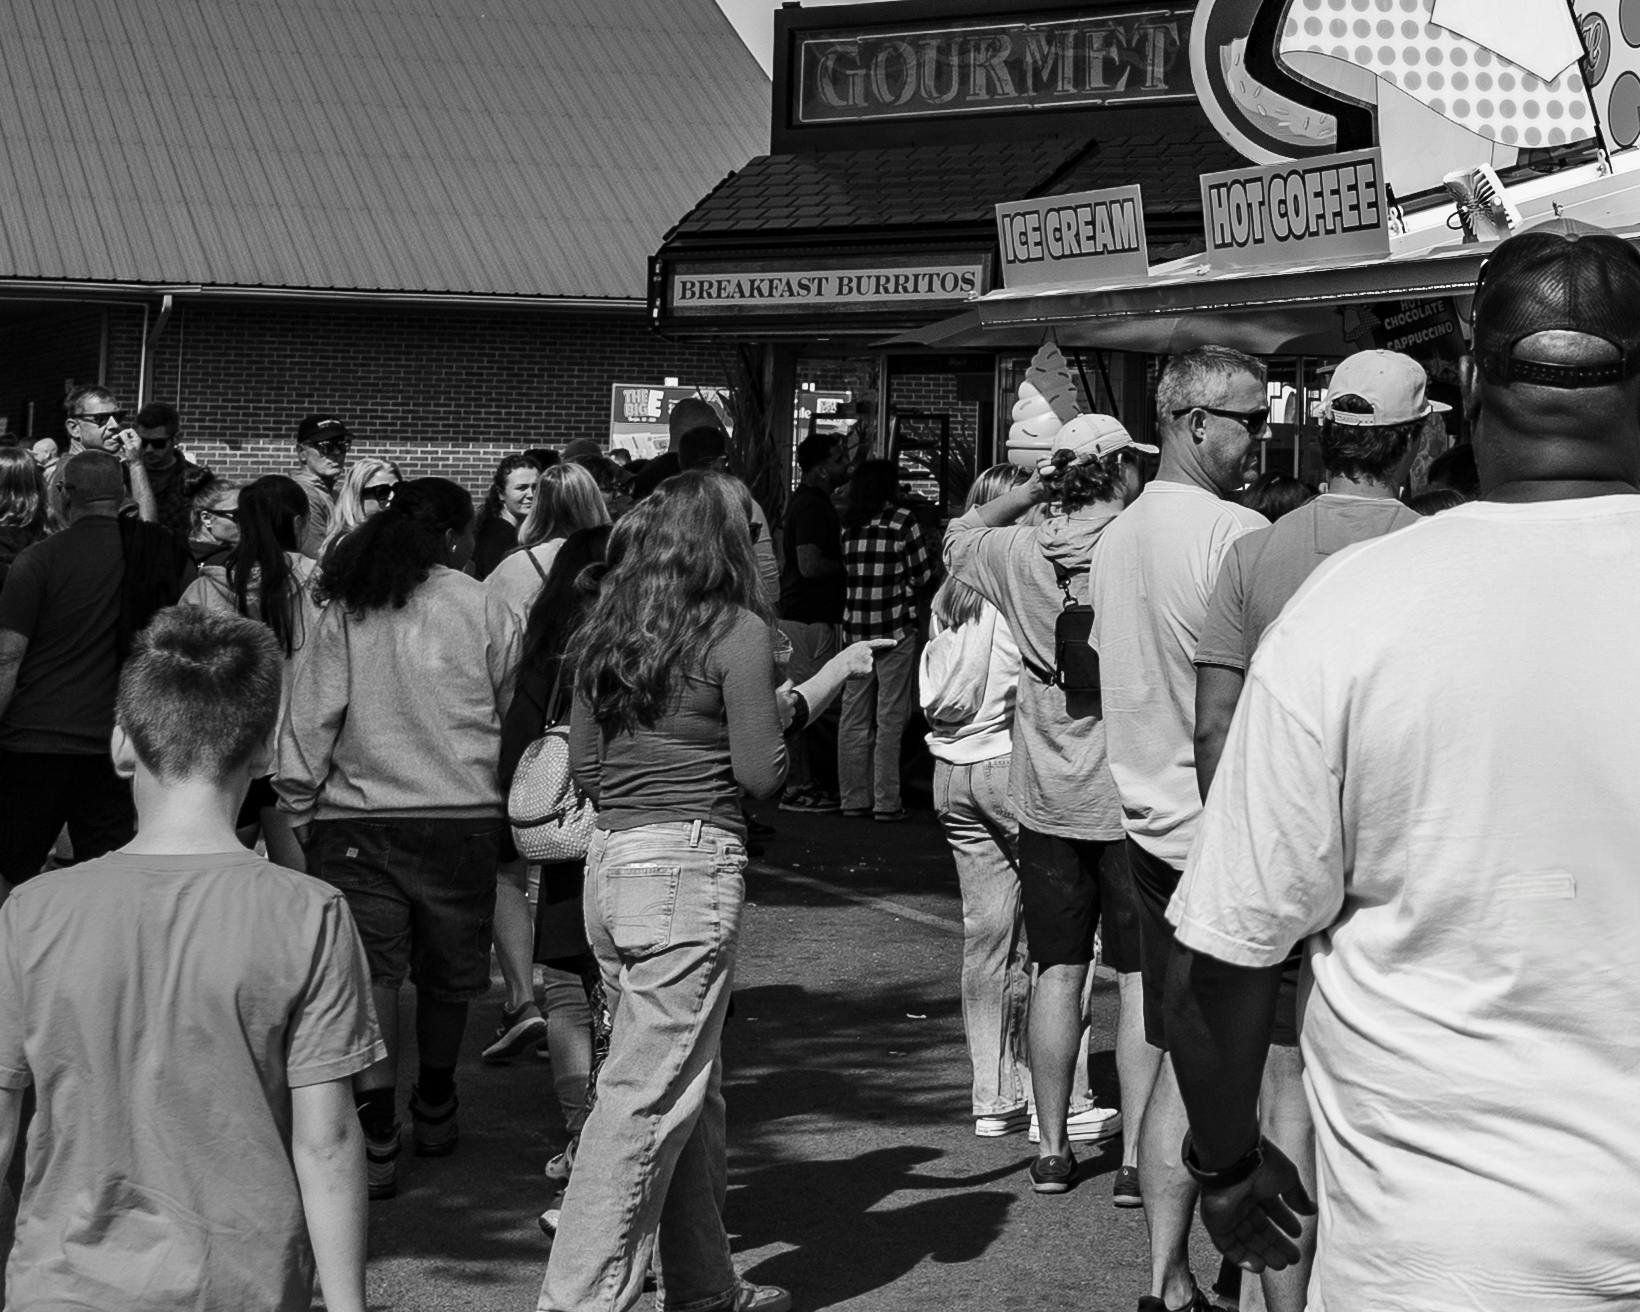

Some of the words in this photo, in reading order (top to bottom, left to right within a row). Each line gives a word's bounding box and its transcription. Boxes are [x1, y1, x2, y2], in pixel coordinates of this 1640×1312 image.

[817, 21, 1181, 107] GOURMET
[1209, 176, 1266, 250] HOT
[1267, 158, 1380, 243] COFFEE
[1002, 209, 1044, 264] ICE
[1043, 198, 1140, 261] CREAM
[679, 275, 830, 301] BREAKFAST
[836, 270, 977, 297] BURRITOS
[1383, 300, 1446, 331] CHOCOLATE
[1386, 321, 1454, 351] CAPPUCCINO
[623, 389, 648, 403] THE
[624, 402, 648, 417] BIG
[648, 389, 664, 417] E
